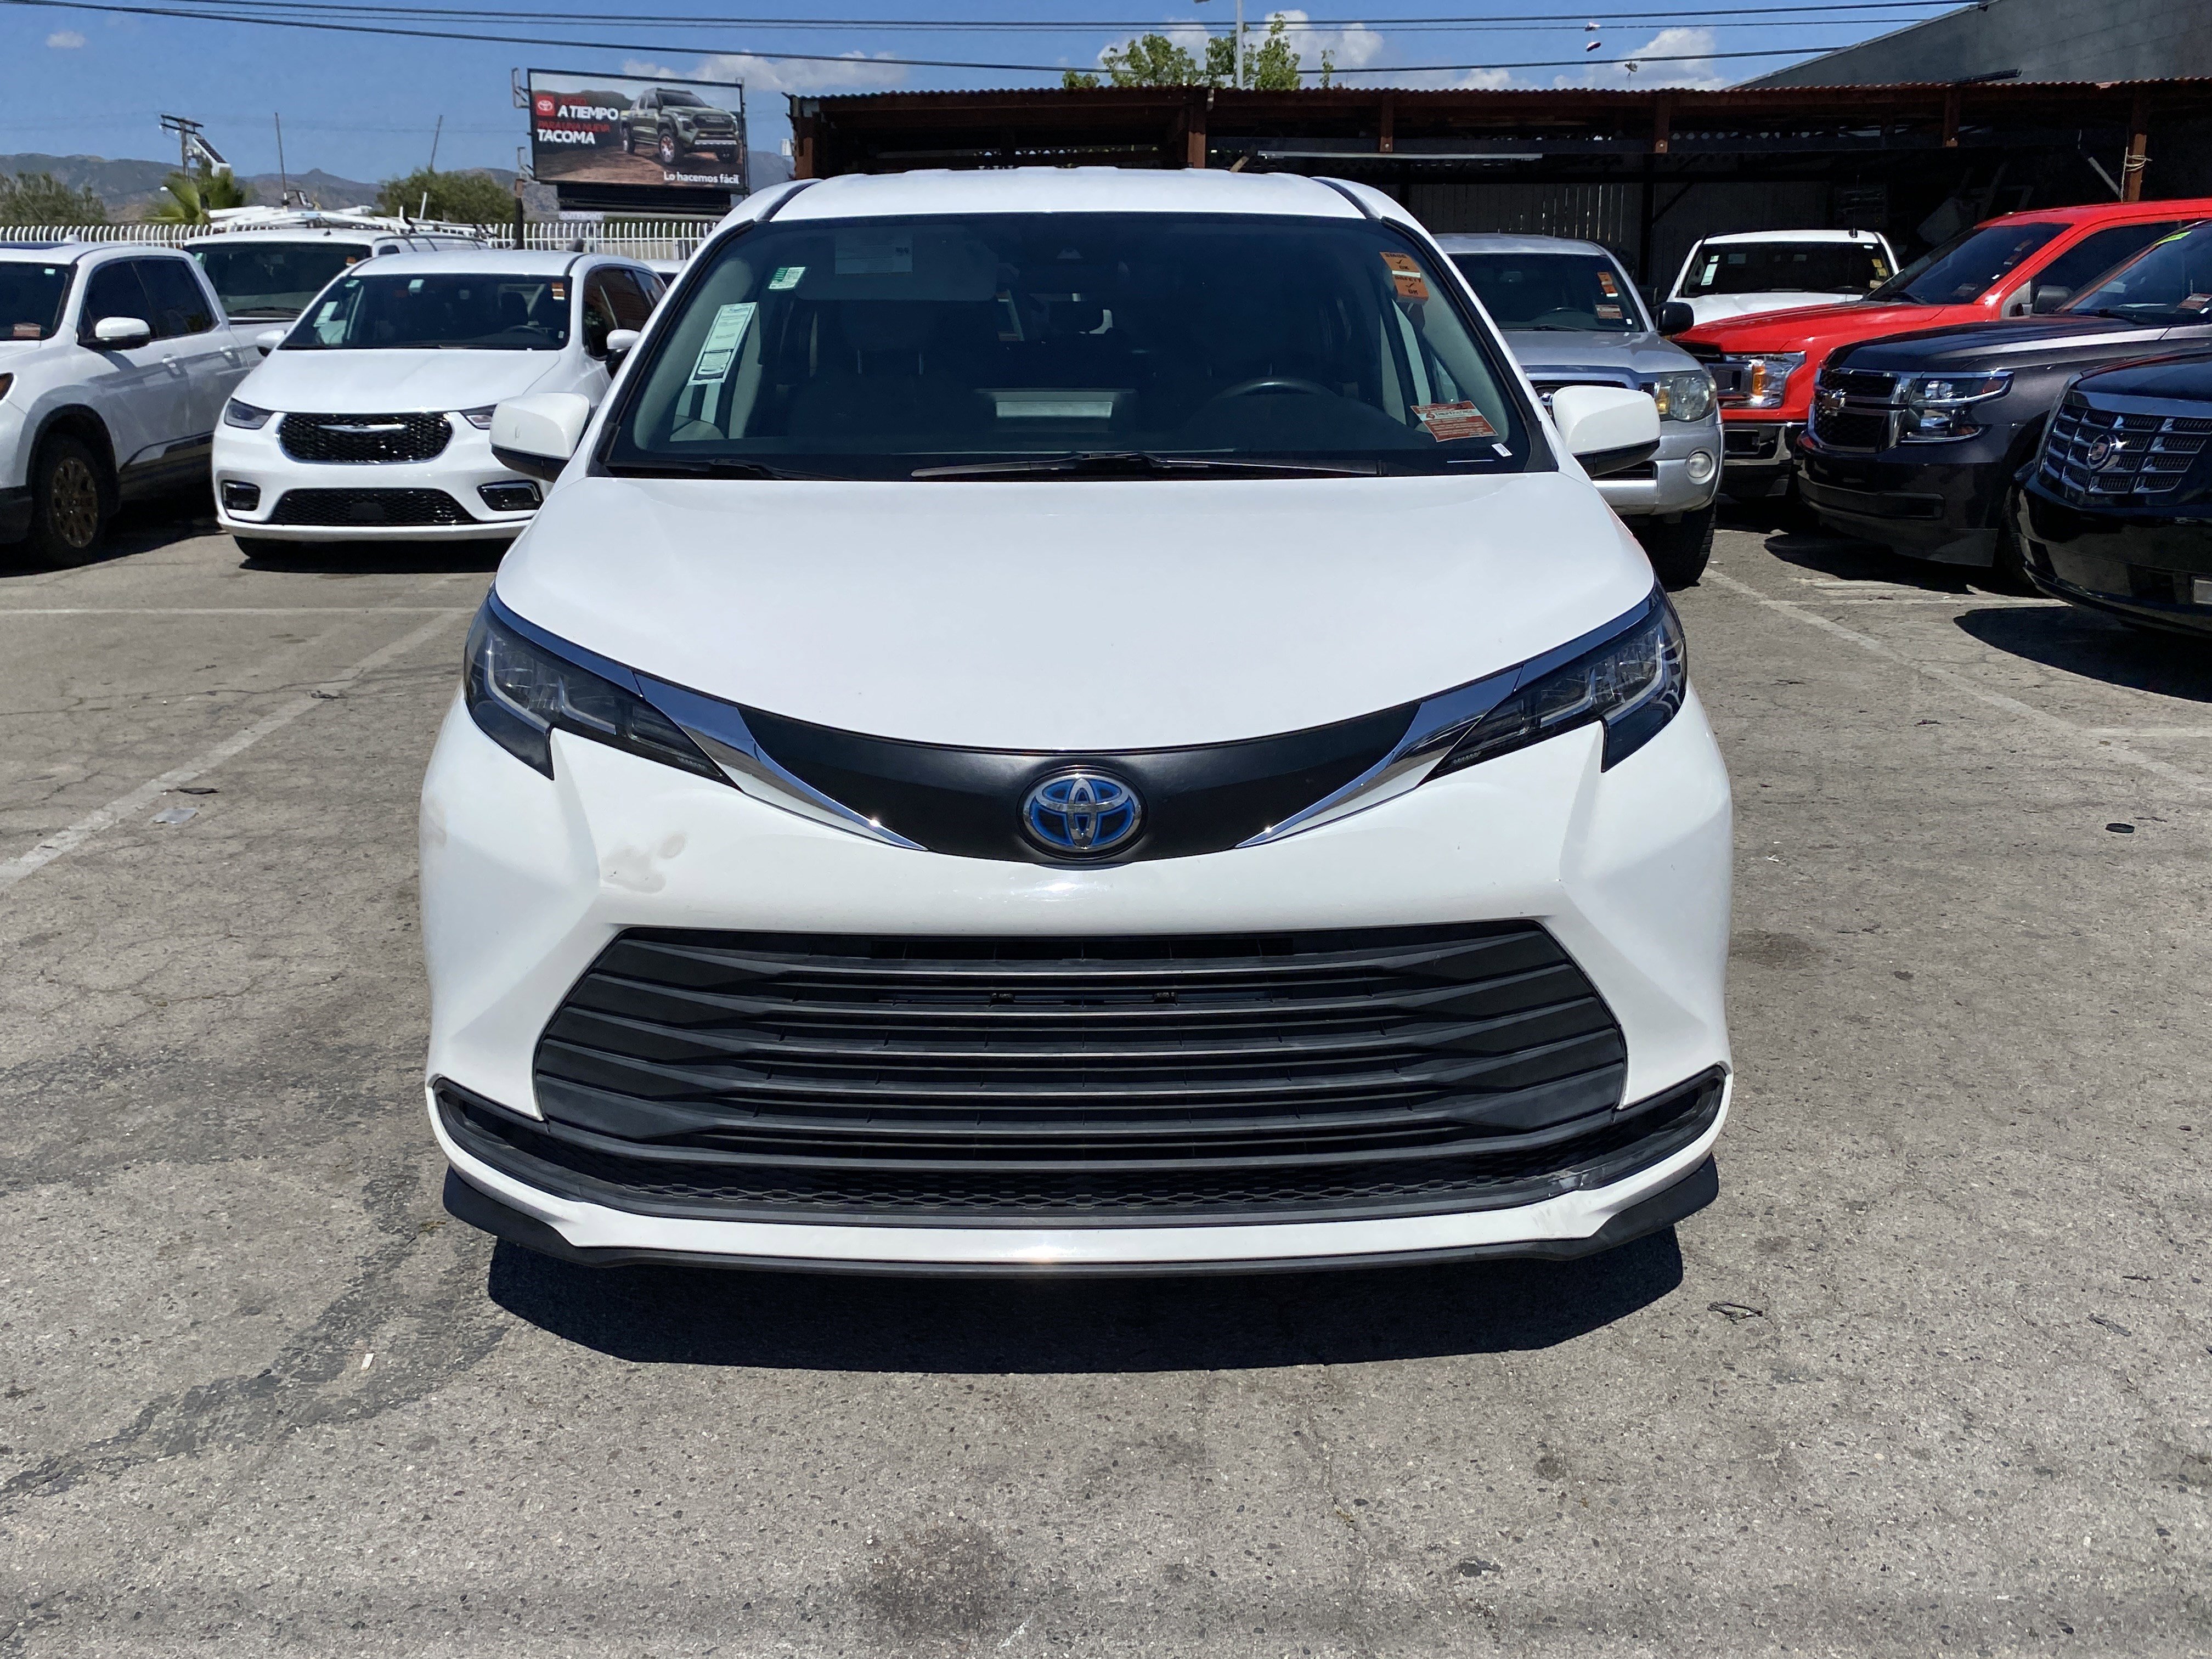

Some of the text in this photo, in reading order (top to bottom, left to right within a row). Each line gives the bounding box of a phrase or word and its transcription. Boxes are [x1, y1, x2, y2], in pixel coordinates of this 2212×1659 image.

[557, 105, 619, 120] A TIEMPO
[537, 128, 595, 144] TACOMA
[664, 171, 675, 180] Lo
[676, 171, 718, 183] hacemos
